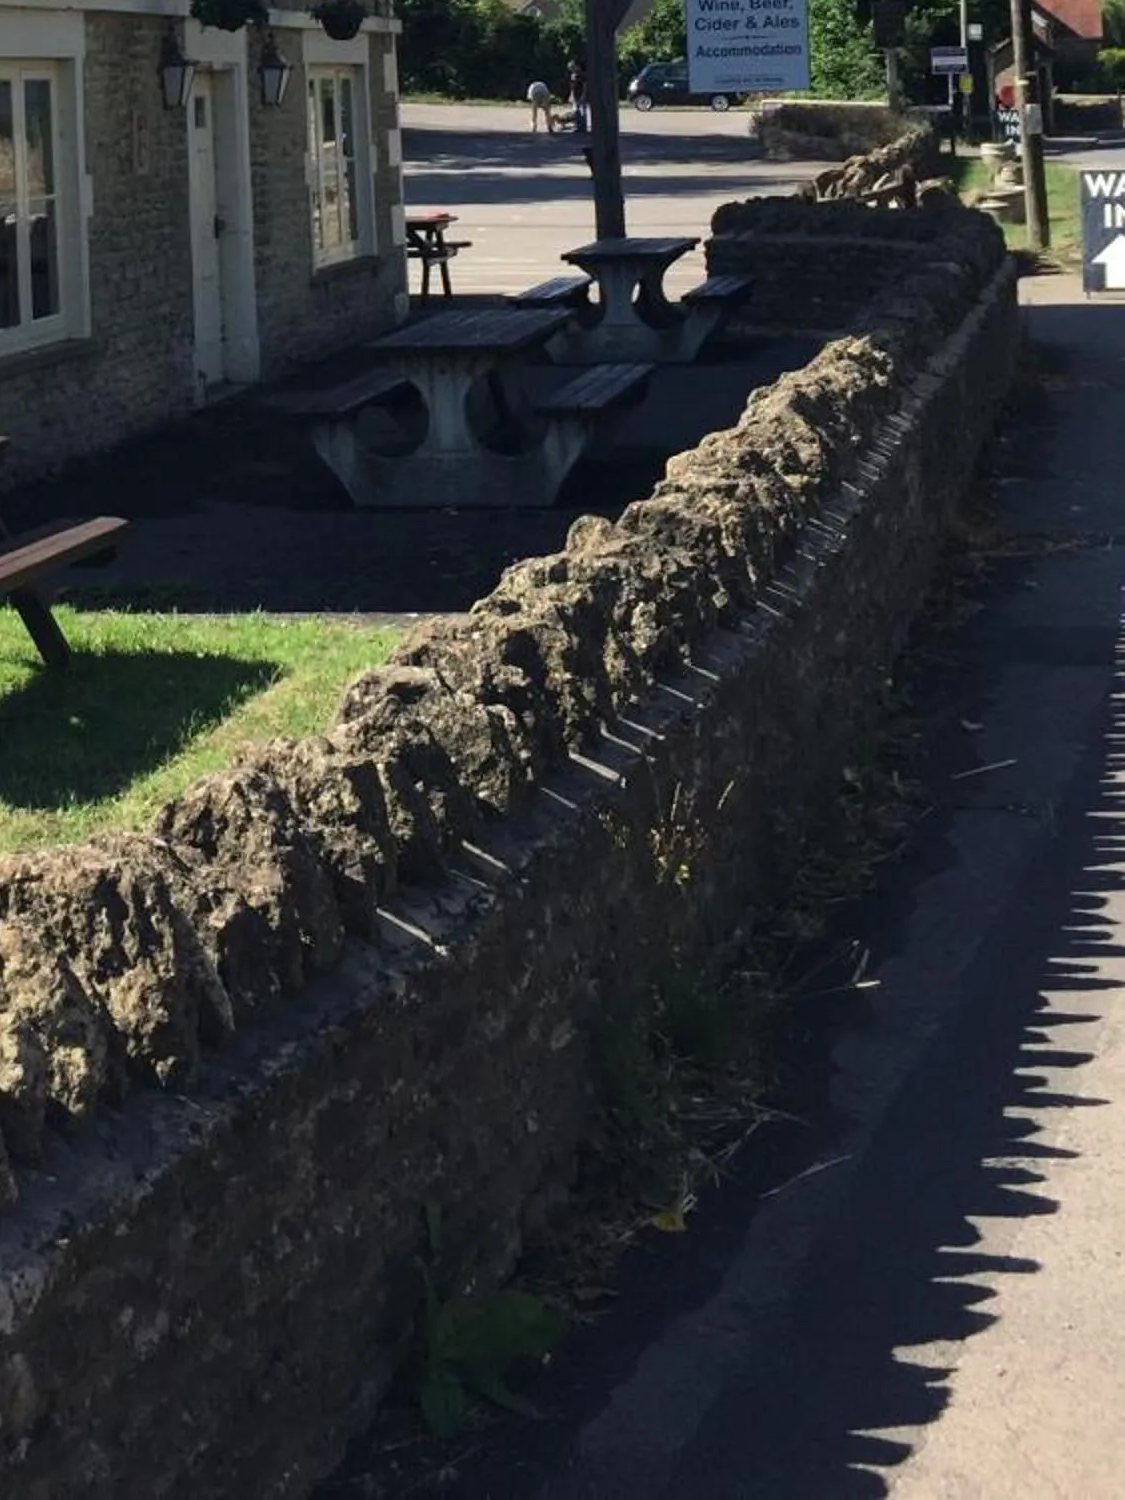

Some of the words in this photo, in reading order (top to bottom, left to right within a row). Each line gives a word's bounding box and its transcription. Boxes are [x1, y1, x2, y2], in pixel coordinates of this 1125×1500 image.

[698, 0, 745, 14] Wine,
[694, 17, 740, 32] Cider
[745, 15, 758, 30] &
[763, 16, 801, 29] Ales
[695, 44, 803, 58] Accommodation
